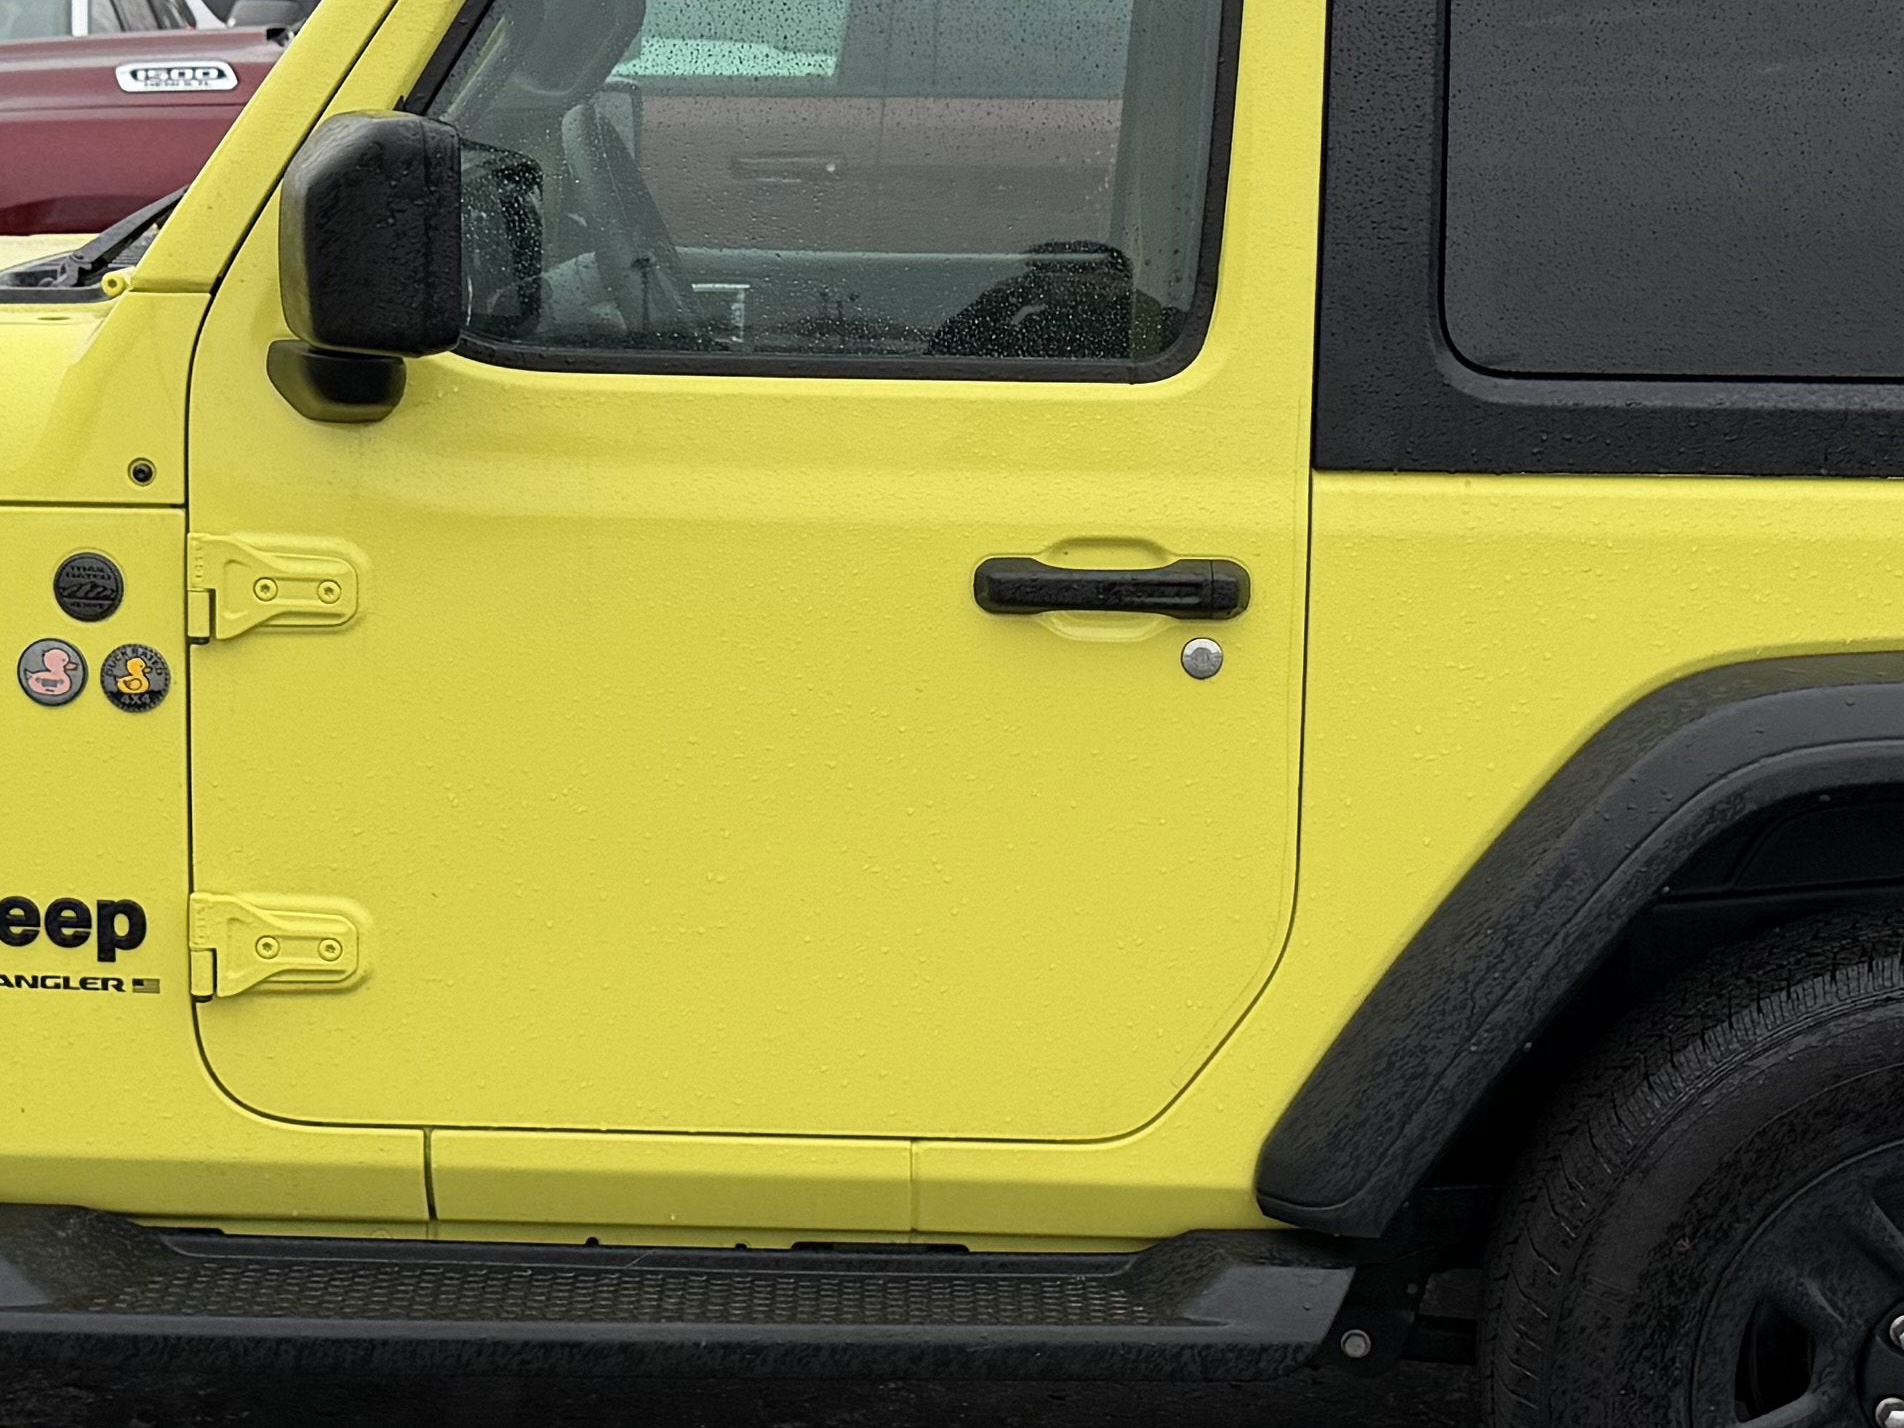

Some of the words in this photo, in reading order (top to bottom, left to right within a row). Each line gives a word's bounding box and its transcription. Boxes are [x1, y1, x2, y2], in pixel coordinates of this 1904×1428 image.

[136, 68, 219, 81] 1500
[105, 649, 130, 677] DUCK
[131, 647, 164, 676] RATED
